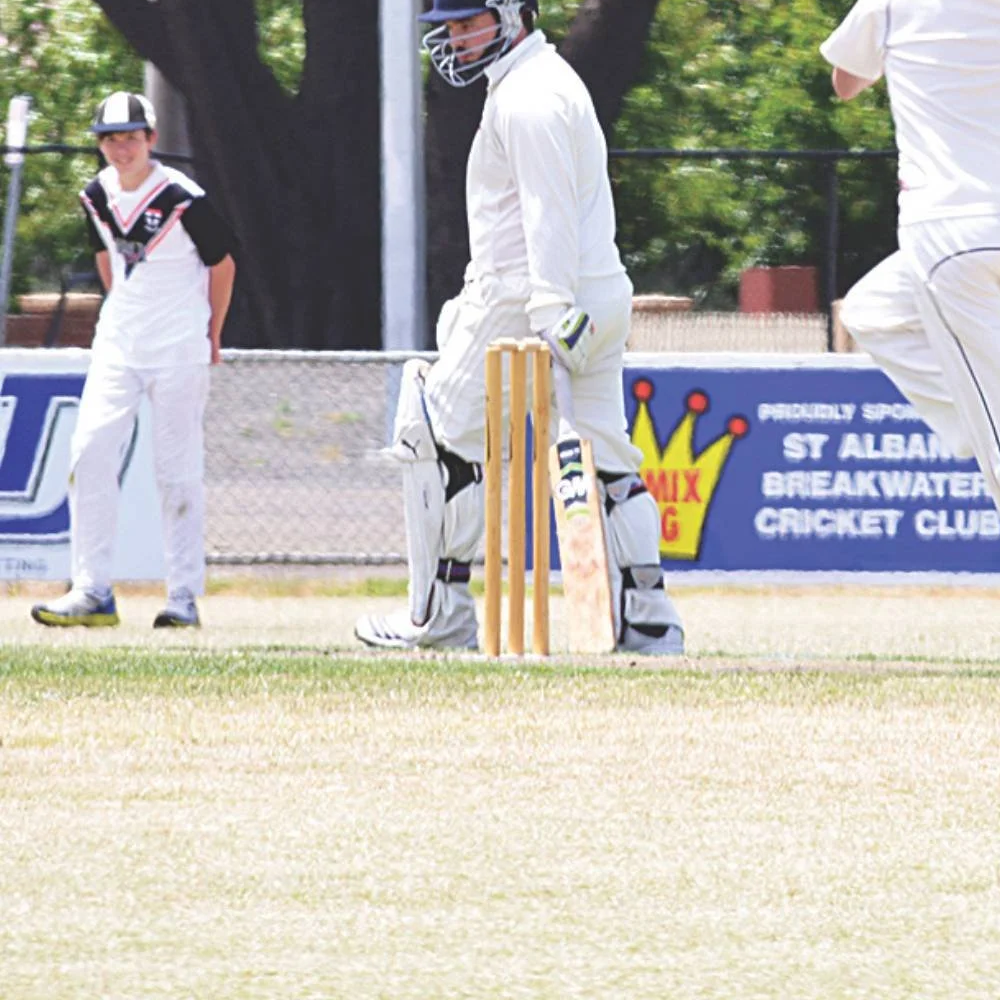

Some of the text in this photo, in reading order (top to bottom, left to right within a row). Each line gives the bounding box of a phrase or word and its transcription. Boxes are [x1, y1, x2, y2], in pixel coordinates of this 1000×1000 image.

[757, 402, 856, 423] PROUDLY
[783, 433, 829, 460] ST
[761, 470, 991, 498] BREAKWATER
[754, 507, 904, 537] CRICKET
